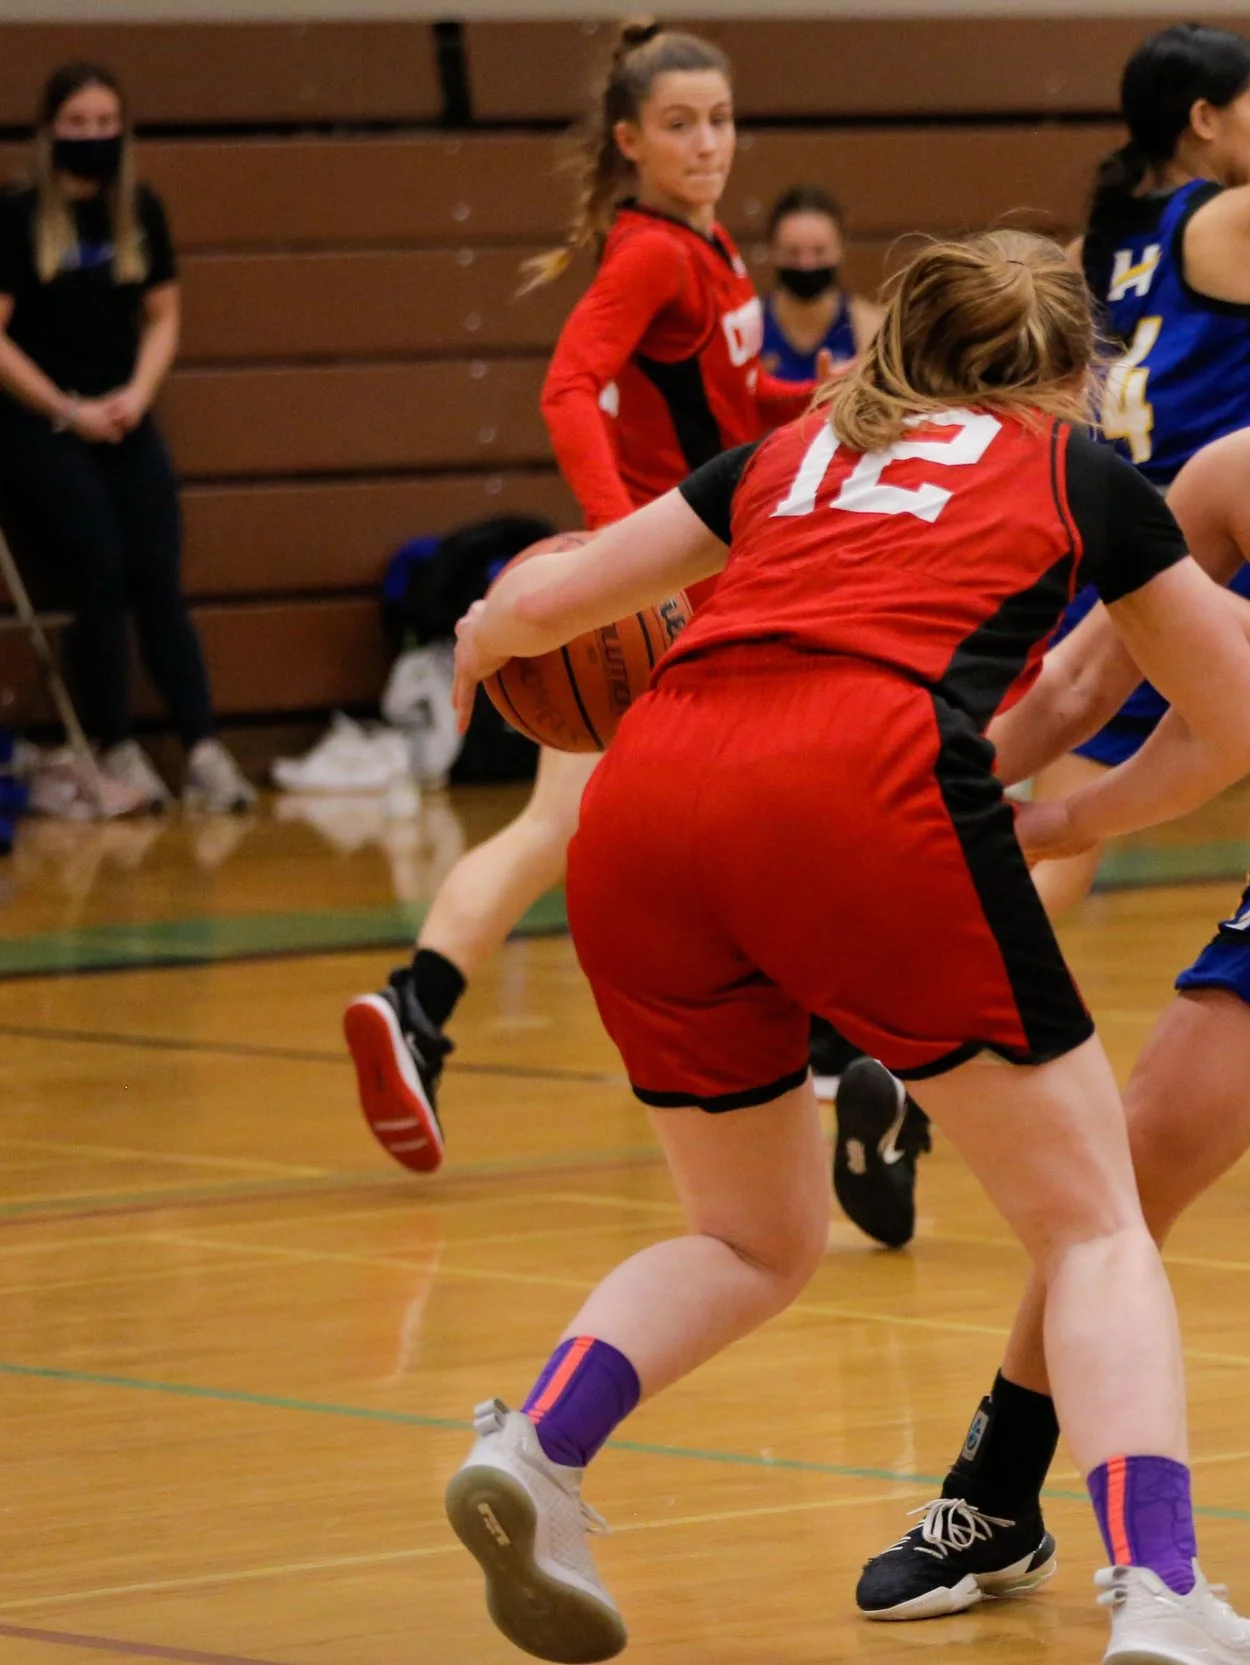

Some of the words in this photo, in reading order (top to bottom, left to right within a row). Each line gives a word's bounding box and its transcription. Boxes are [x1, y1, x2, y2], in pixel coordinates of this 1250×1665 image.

[1107, 243, 1162, 301] H
[1102, 314, 1164, 465] 4
[768, 407, 1002, 524] 12
